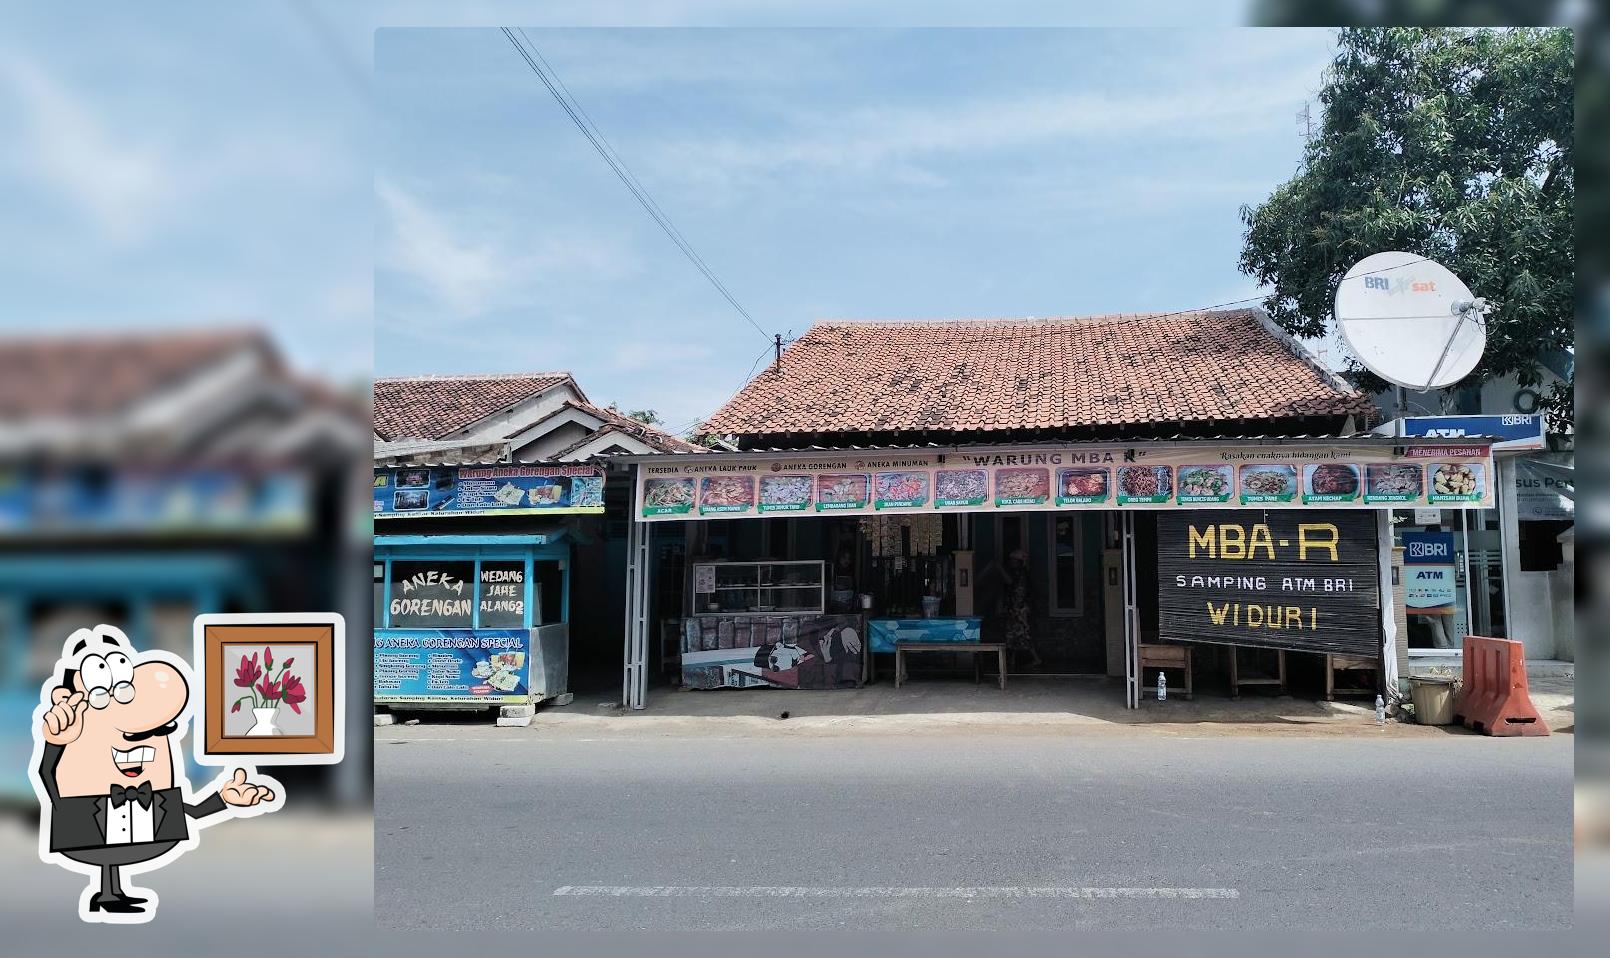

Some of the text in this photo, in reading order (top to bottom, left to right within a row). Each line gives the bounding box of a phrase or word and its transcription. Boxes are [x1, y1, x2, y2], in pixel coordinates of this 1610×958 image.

[1365, 276, 1437, 292] BRI sat
[1513, 415, 1532, 425] BRI
[1071, 452, 1114, 464] MBA
[1412, 448, 1481, 456] MENERIMA PESANAN
[492, 467, 519, 478] Aneka
[519, 467, 560, 477] Gorengan
[561, 465, 595, 476] Special
[808, 462, 847, 470] GORENGAN
[1424, 543, 1448, 556] BRI
[480, 570, 524, 584] WEDANG
[1416, 571, 1443, 580] ATM
[401, 571, 464, 596] ANEKA
[1176, 575, 1353, 592] SAMPING ATM BRI
[486, 584, 518, 597] JAHE
[390, 598, 472, 617] GORENGAN
[1207, 601, 1318, 631] WIDURI
[385, 637, 420, 649] ANEKA
[422, 637, 480, 649] GORENGAN
[480, 637, 524, 649] SPECIAL
